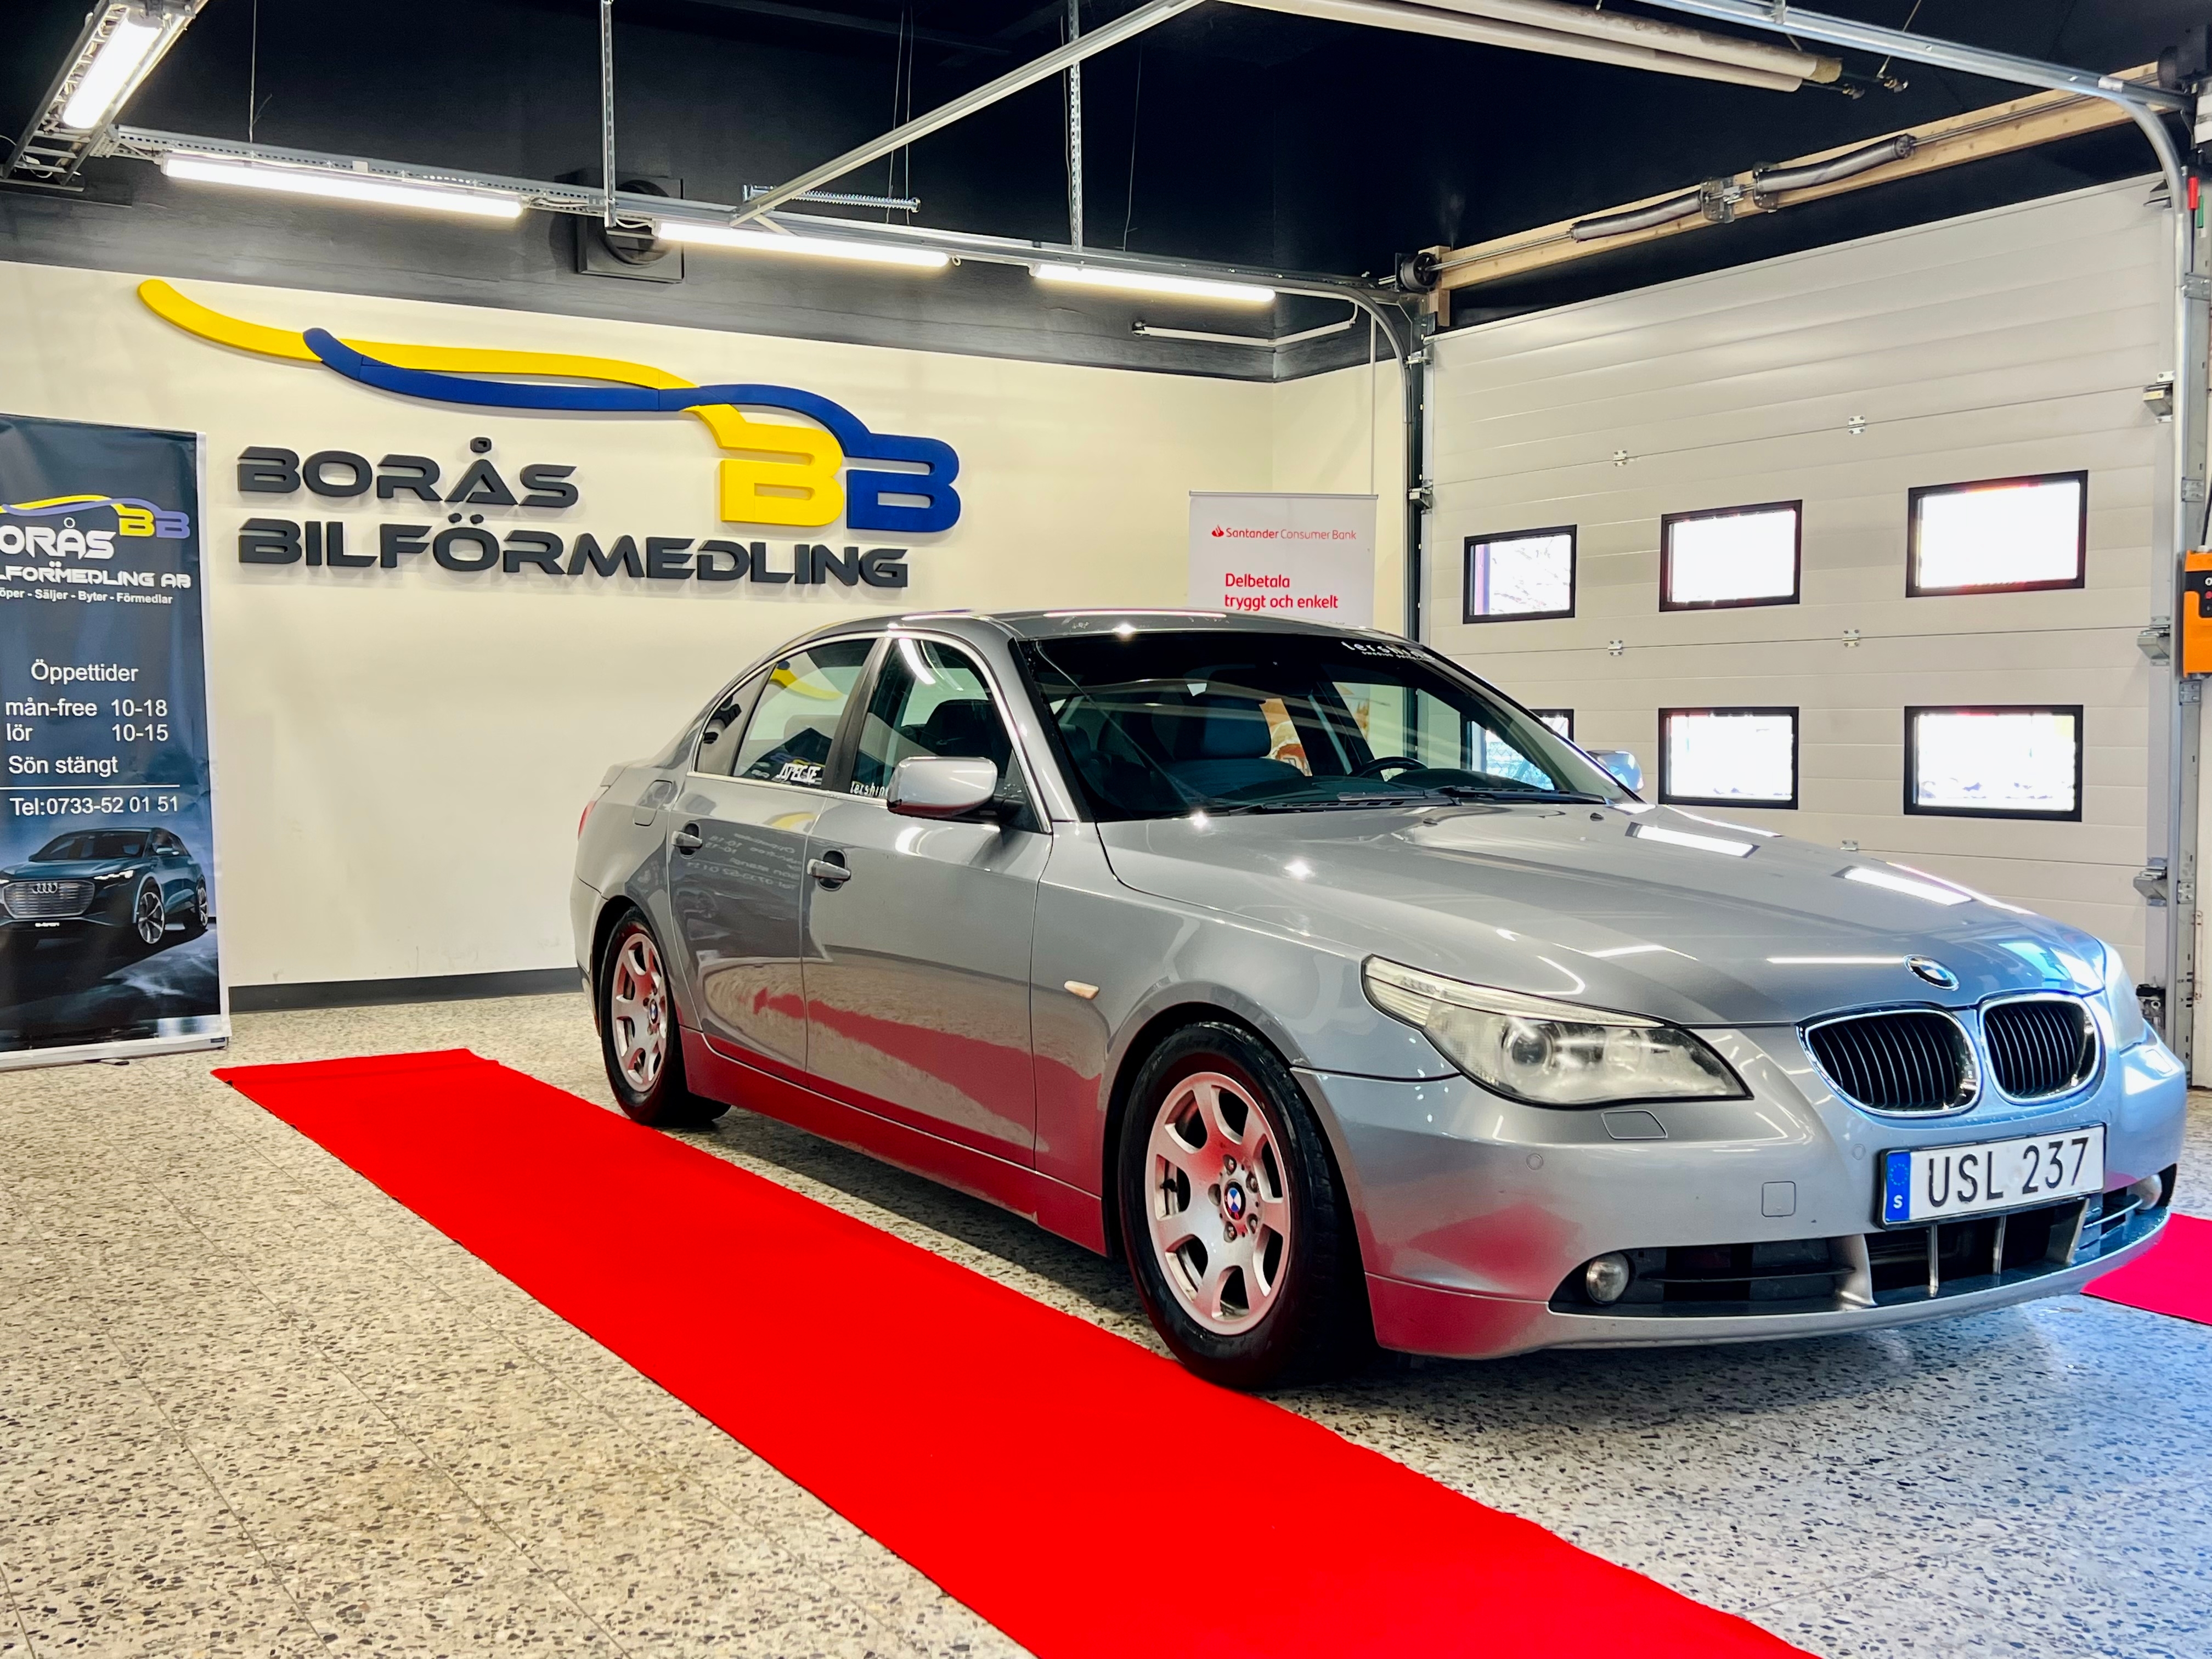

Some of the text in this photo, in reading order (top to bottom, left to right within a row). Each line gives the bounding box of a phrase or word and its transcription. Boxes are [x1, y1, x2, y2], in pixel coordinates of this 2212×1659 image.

[238, 437, 579, 508] BORÅS
[1226, 527, 1357, 540] Santander Consumer Bank
[238, 512, 909, 588] BILFÖRMEDLING
[161, 573, 191, 589] AB
[1225, 573, 1290, 588] Delbetala
[35, 589, 68, 601] Säljer
[78, 590, 108, 603] Byter
[117, 592, 173, 604] Förmedlar
[1224, 594, 1339, 611] tryggt och enkelt
[31, 659, 139, 685] Öppettider
[5, 697, 168, 717] mån-free 10-18
[6, 723, 168, 742] lör 10-15
[8, 755, 119, 778] Sön stängt
[9, 795, 178, 816] Tel:0733-52 01 51
[1928, 1136, 2090, 1207] USL 237
[1893, 1194, 1903, 1209] S
